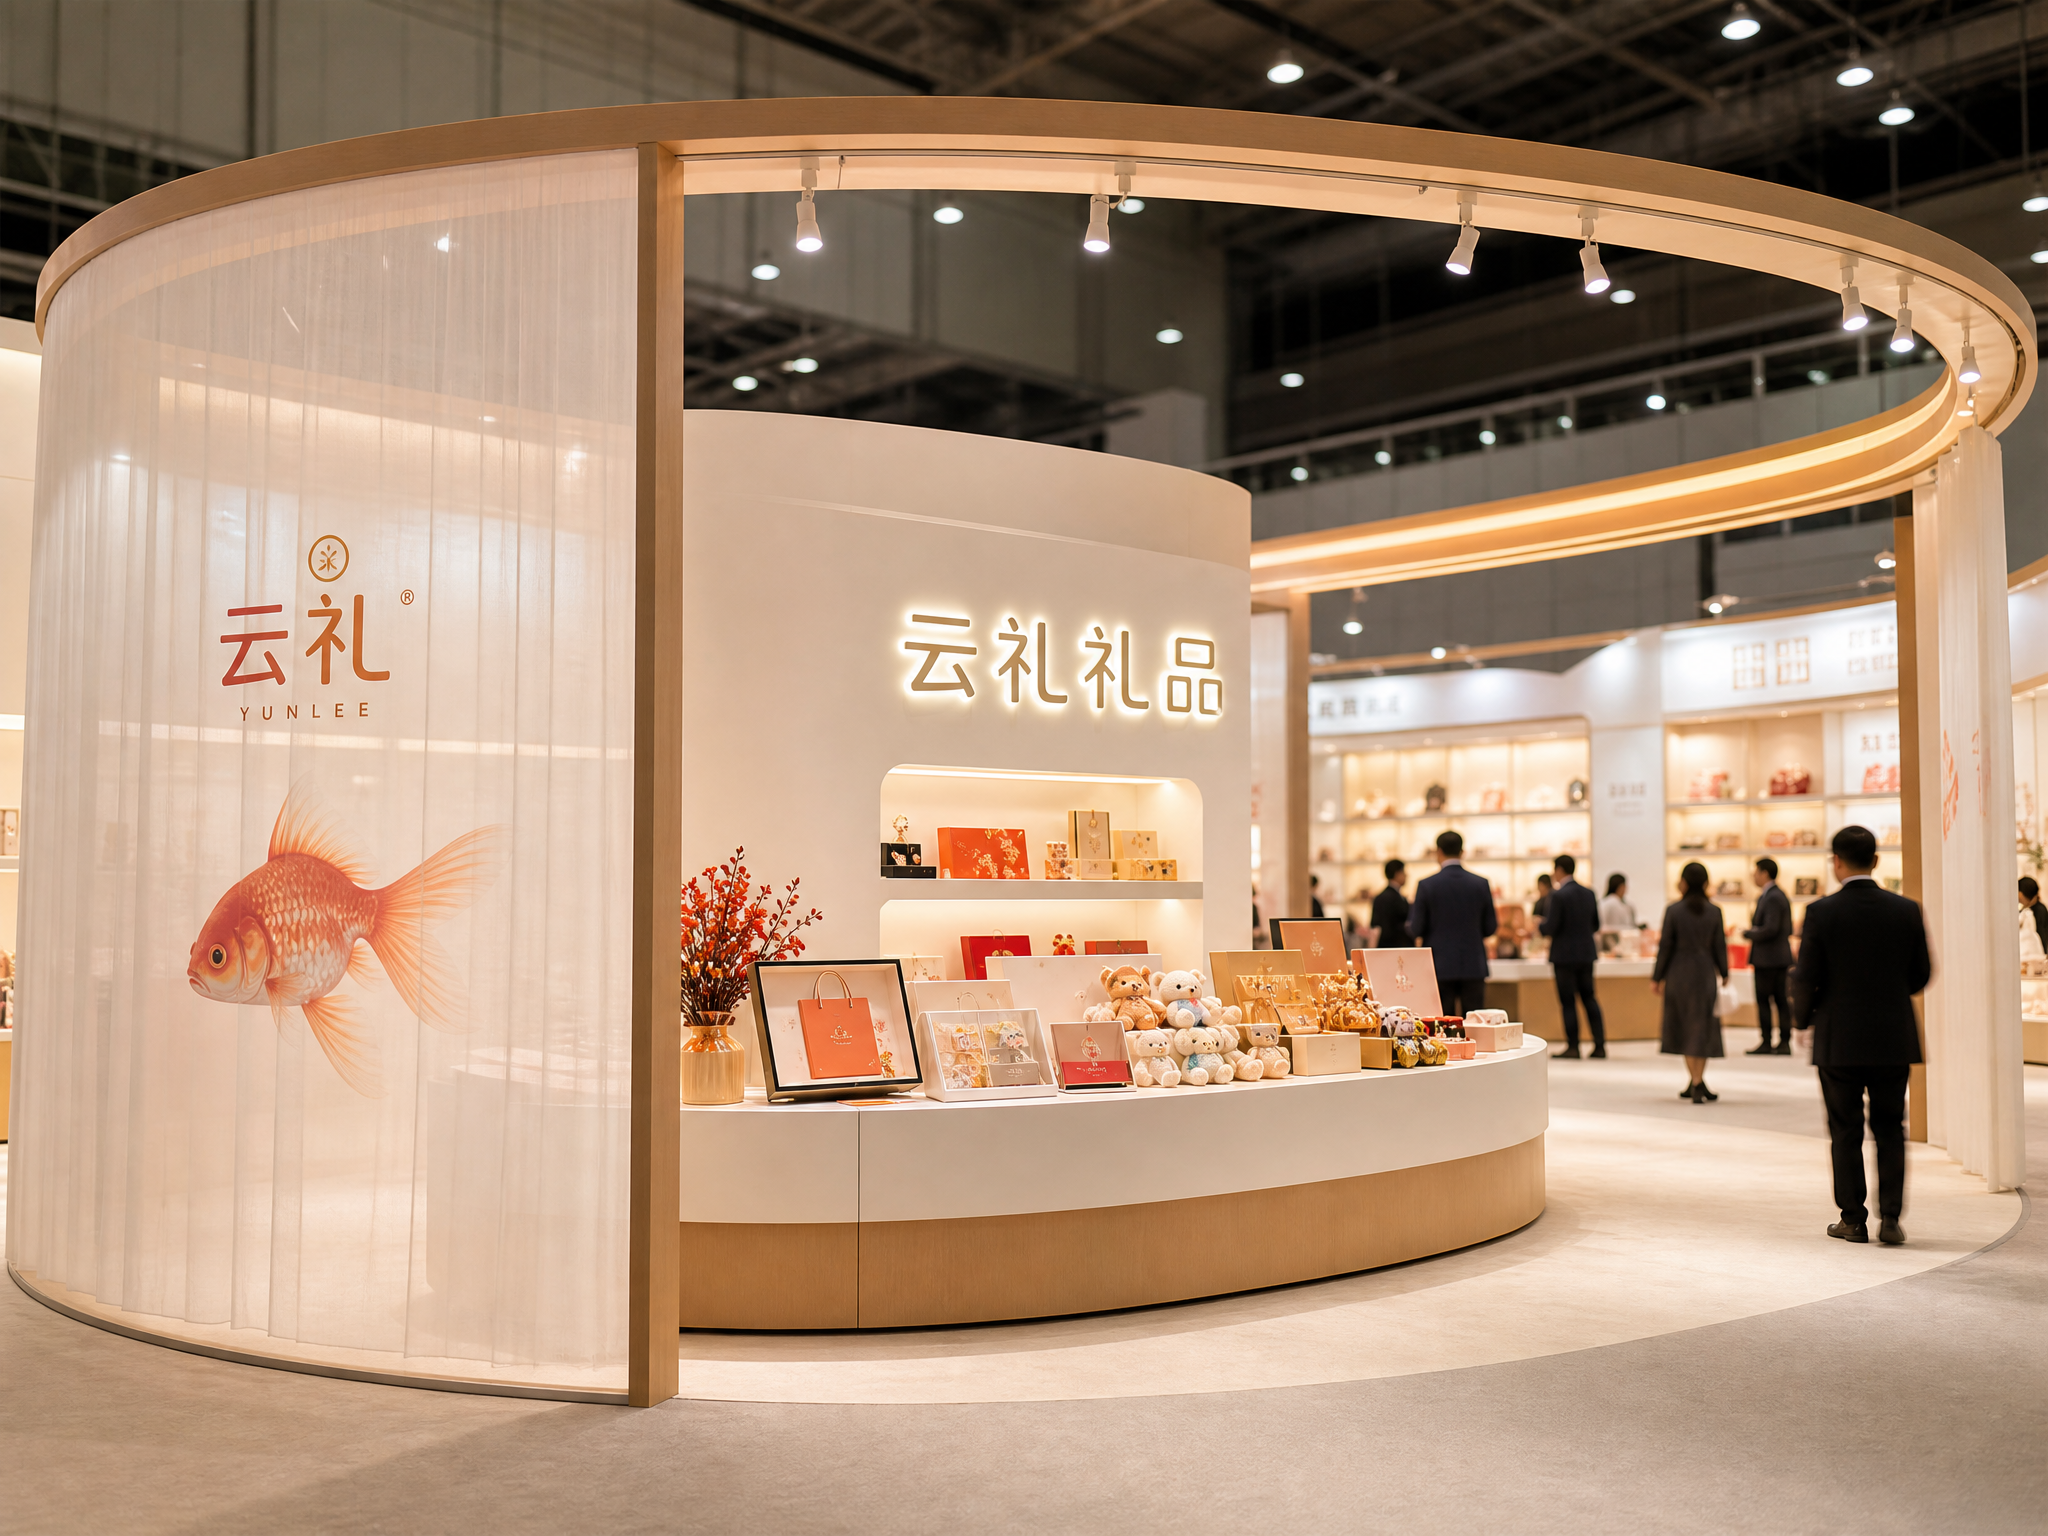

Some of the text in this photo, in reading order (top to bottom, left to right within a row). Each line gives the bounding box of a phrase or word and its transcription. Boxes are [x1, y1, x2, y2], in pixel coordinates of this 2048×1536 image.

[220, 593, 391, 686] 云礼
[904, 613, 1223, 716] 云礼礼品
[240, 702, 369, 721] YUNLEE
